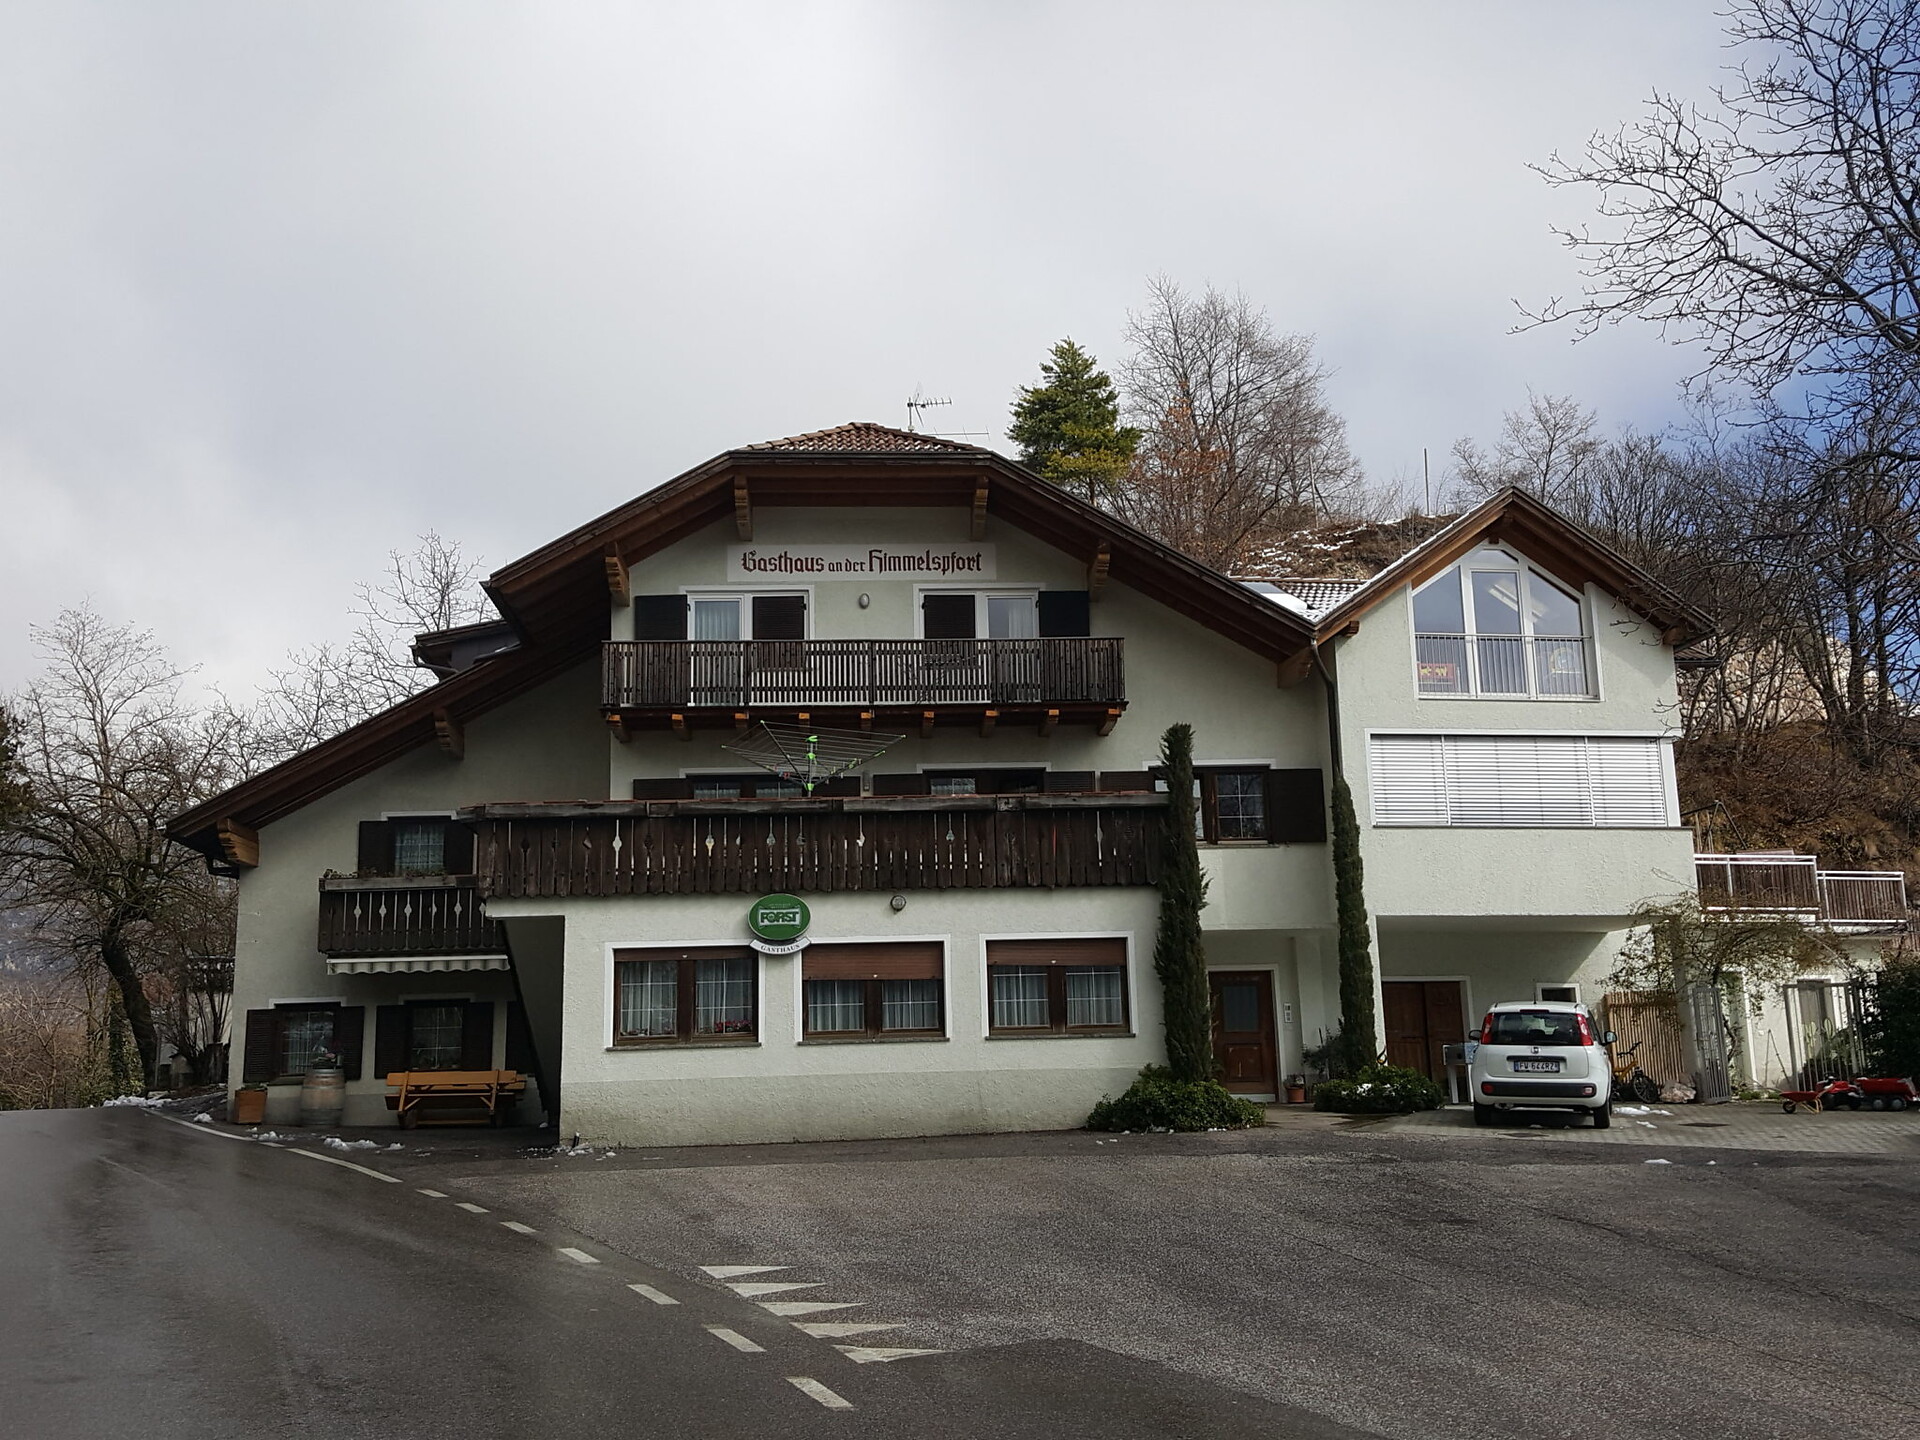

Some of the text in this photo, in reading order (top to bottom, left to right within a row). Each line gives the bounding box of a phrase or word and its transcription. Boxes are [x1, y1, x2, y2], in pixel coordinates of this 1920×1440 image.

[741, 549, 982, 576] Gasthaus an der Himmelspfort
[760, 911, 799, 923] FORST
[760, 944, 800, 953] GASTHAUS
